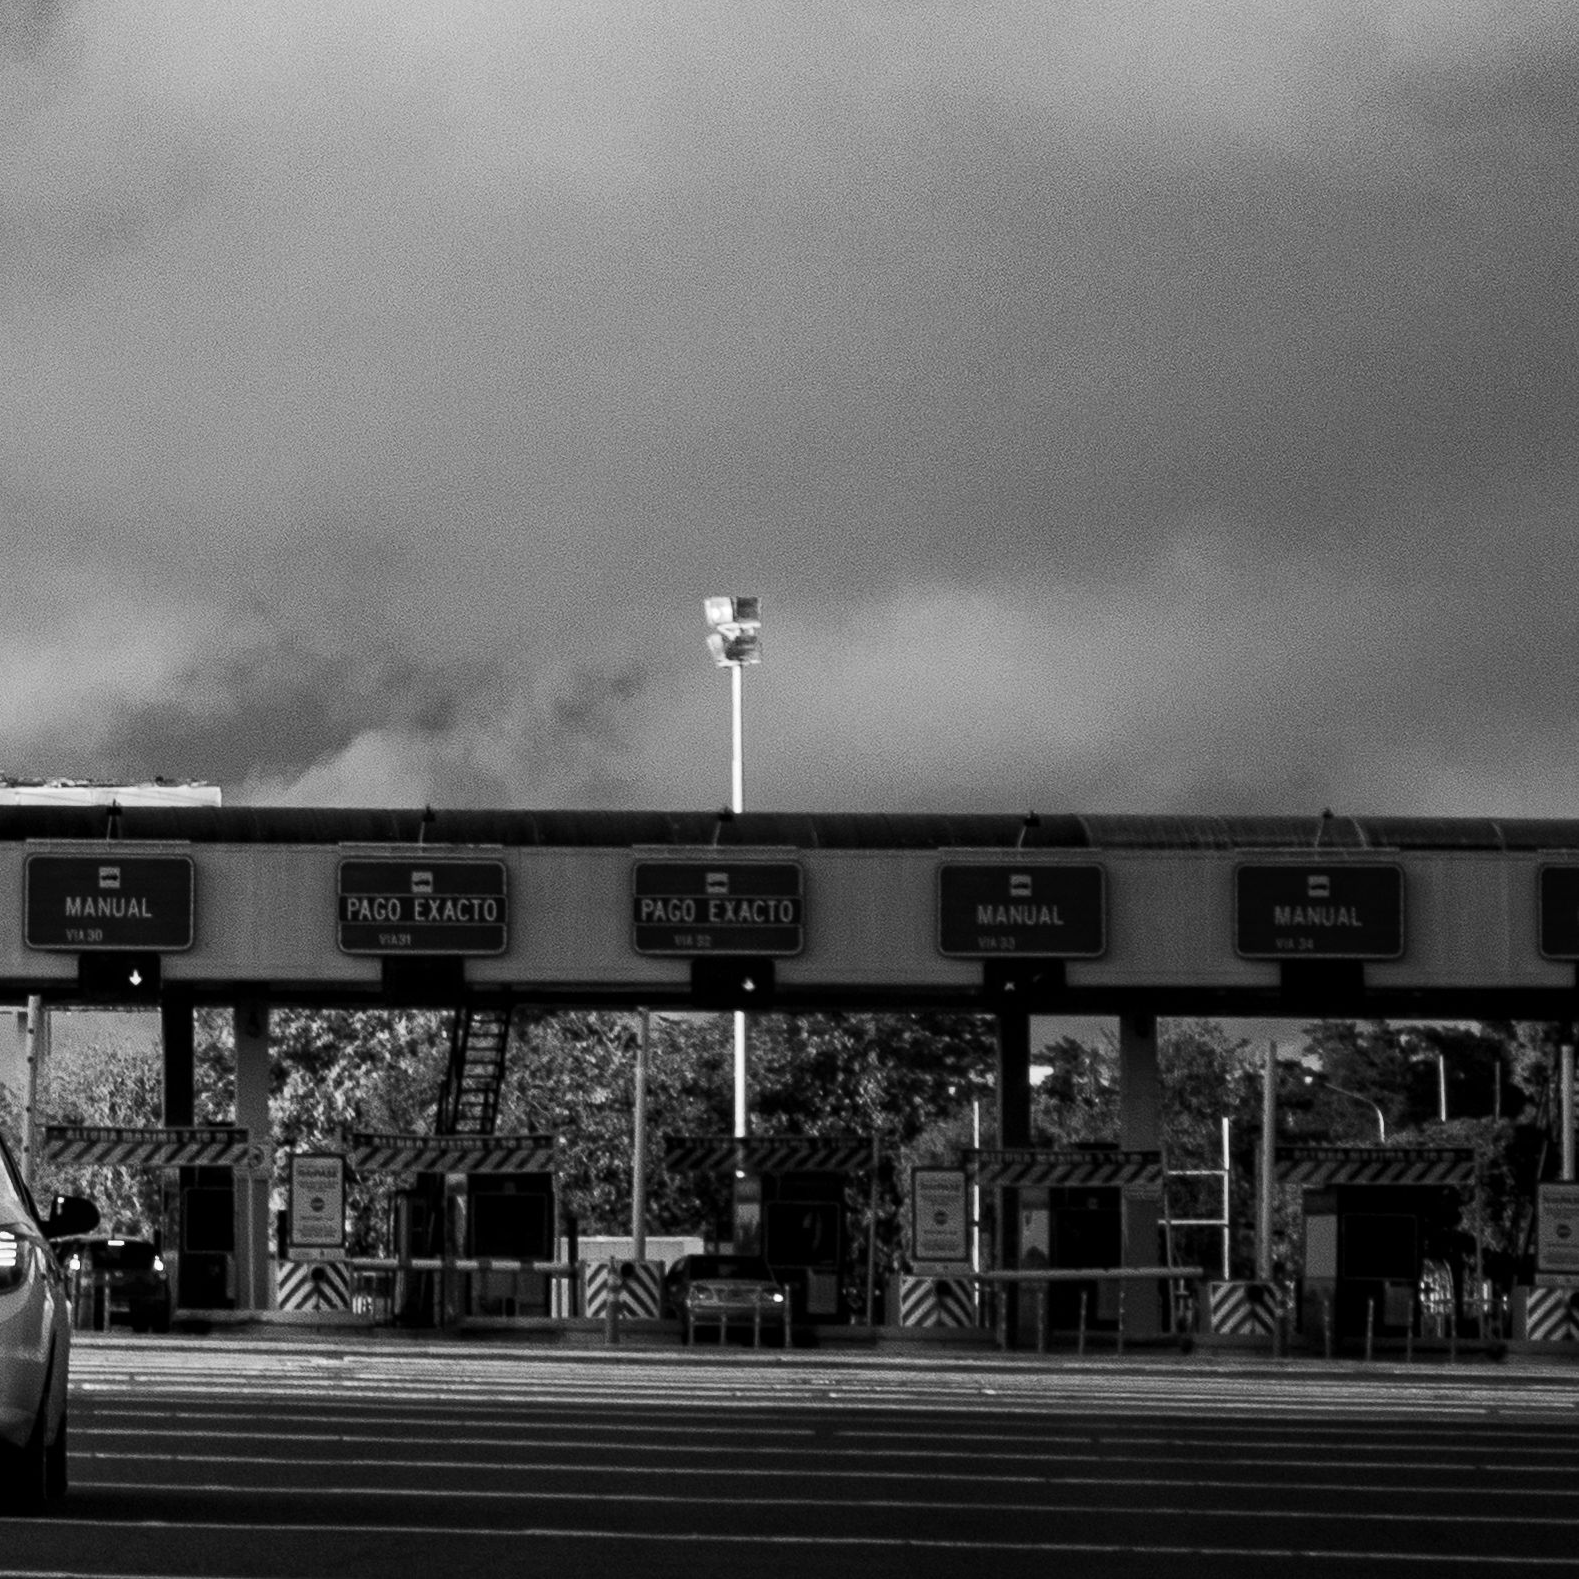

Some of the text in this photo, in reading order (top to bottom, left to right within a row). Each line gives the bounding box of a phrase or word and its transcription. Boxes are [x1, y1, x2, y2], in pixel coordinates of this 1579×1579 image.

[65, 896, 153, 918] MANUAL
[347, 898, 497, 922] PAGO EXACTO
[641, 899, 795, 922] PAGO EXACTO
[976, 904, 1065, 926] MANUAL
[1273, 906, 1363, 928] MANUAL
